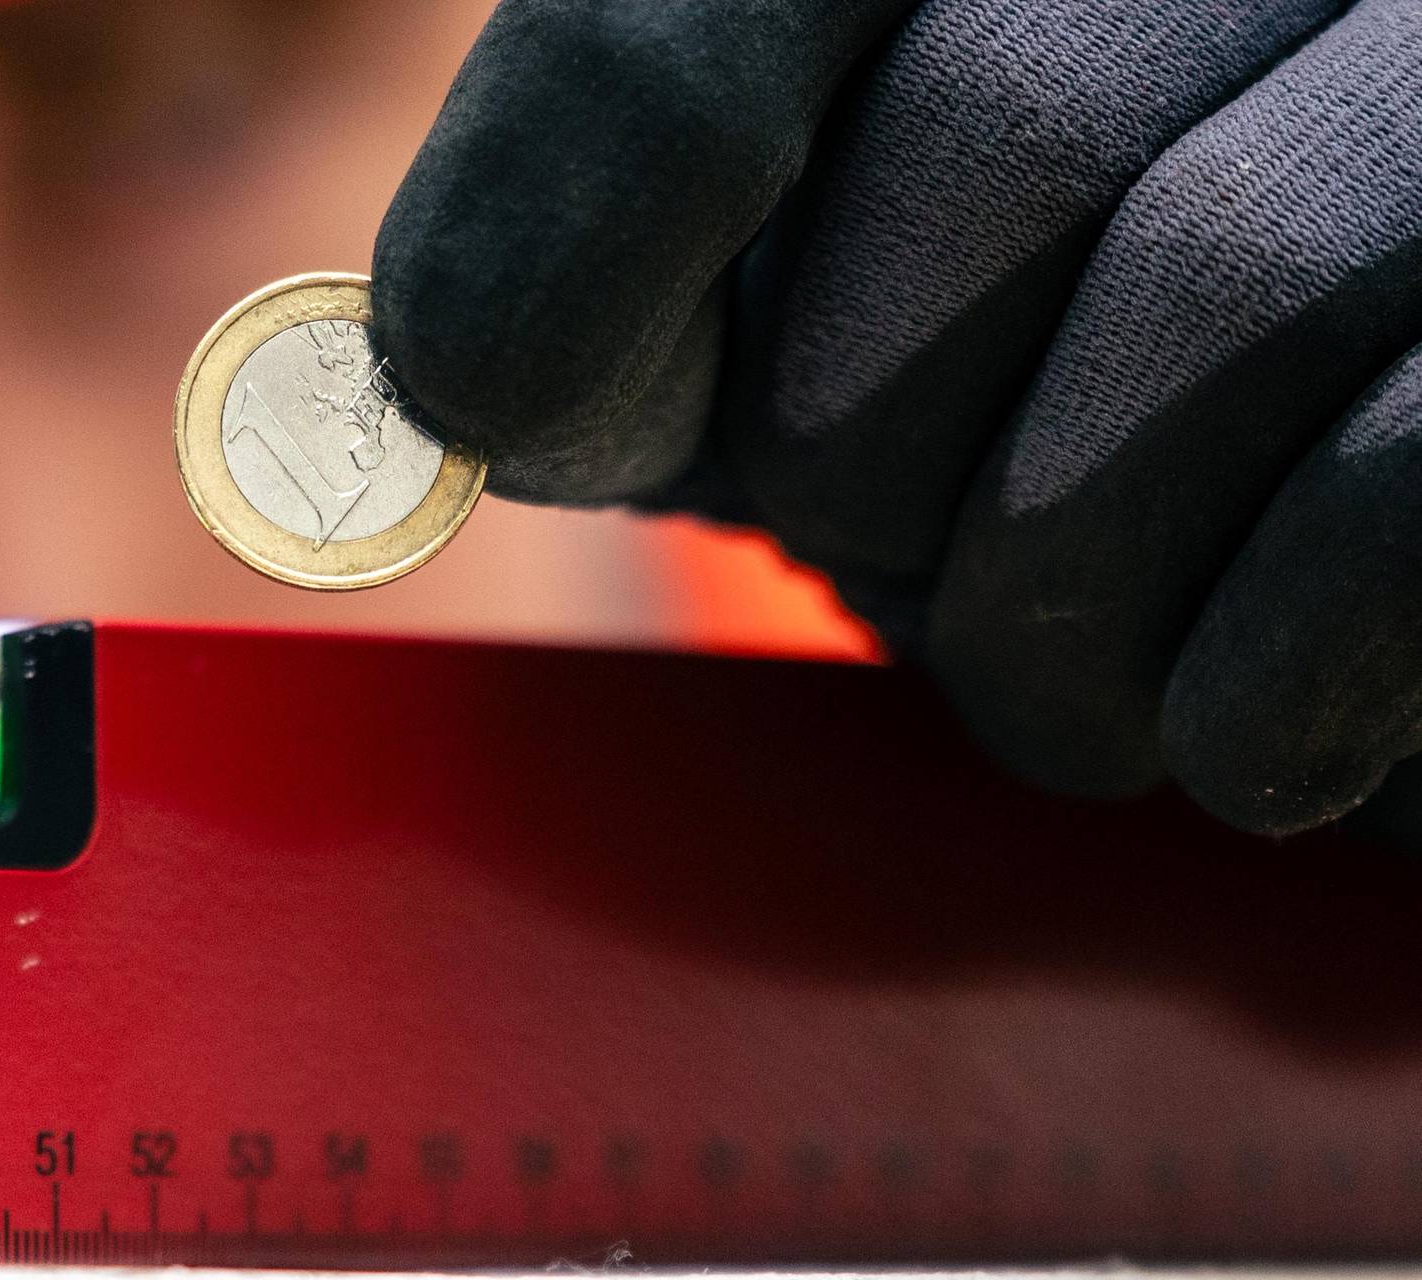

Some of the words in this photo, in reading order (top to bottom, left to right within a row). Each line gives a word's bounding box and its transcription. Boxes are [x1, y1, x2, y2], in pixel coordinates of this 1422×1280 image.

[228, 382, 370, 552] 1
[35, 1131, 75, 1176] 51
[131, 1131, 176, 1178] 52
[228, 1132, 276, 1178] 53
